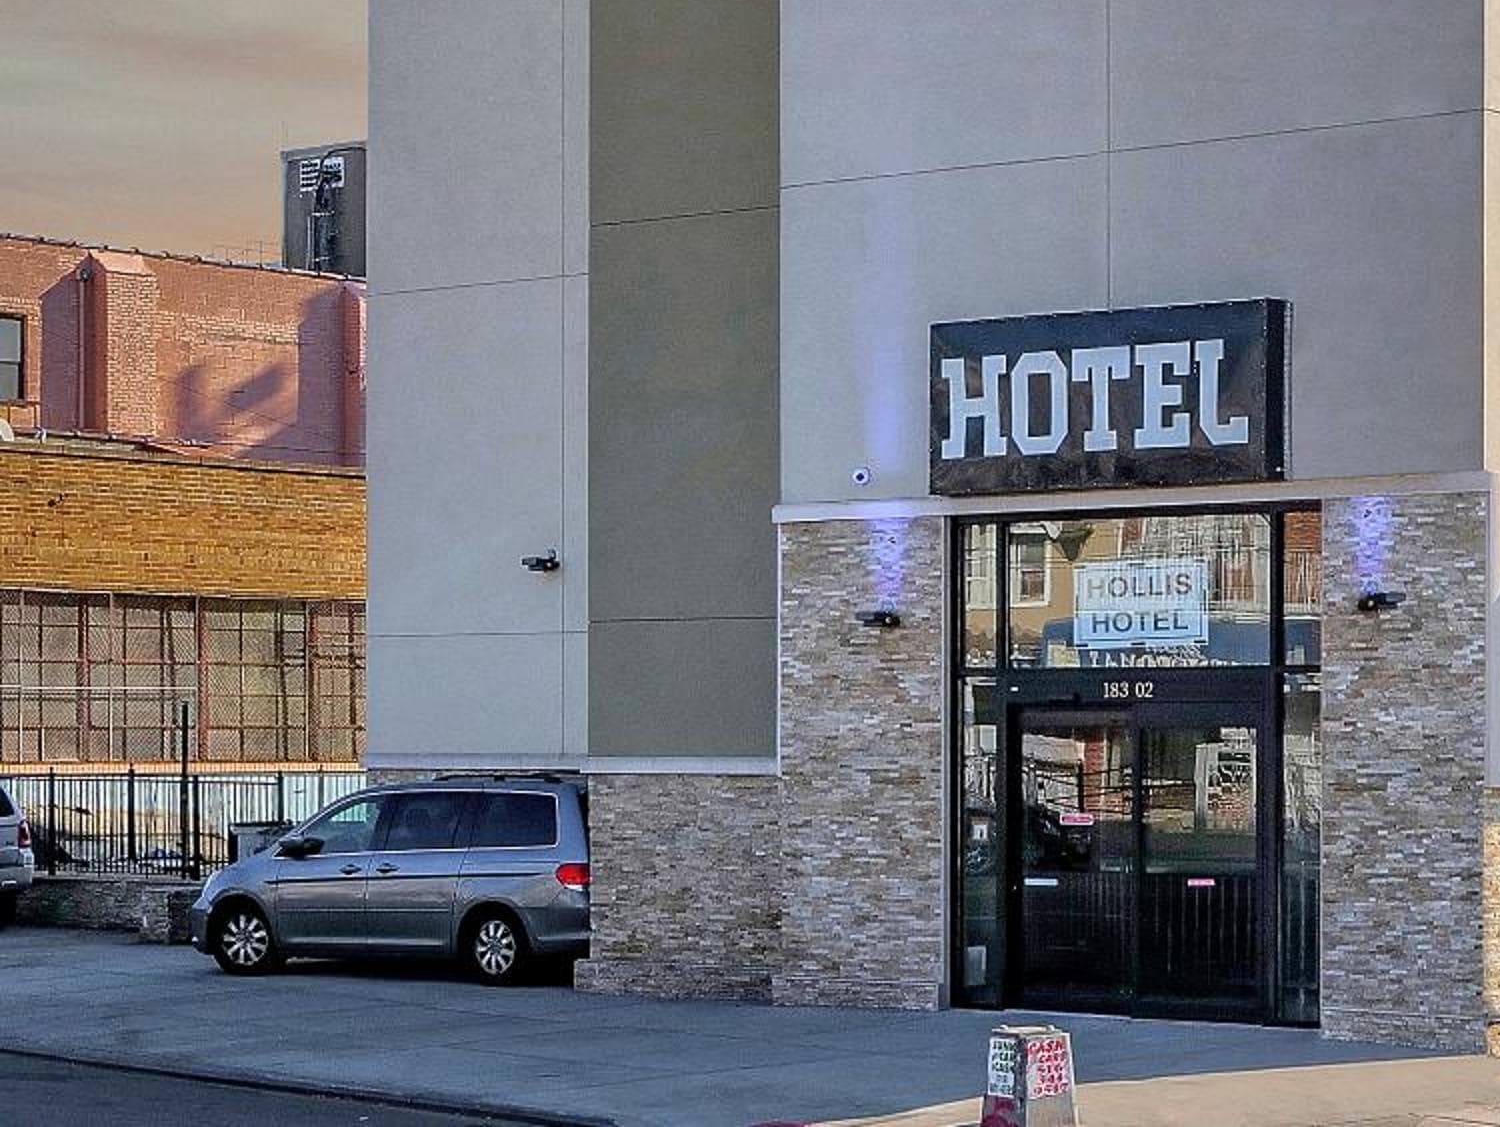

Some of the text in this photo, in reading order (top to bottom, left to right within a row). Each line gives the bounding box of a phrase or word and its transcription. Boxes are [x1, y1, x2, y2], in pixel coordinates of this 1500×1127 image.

[941, 339, 1249, 459] HOTEL
[1087, 572, 1193, 599] HOLLIS
[1091, 610, 1189, 633] HOTEL
[1103, 681, 1154, 699] 183 02
